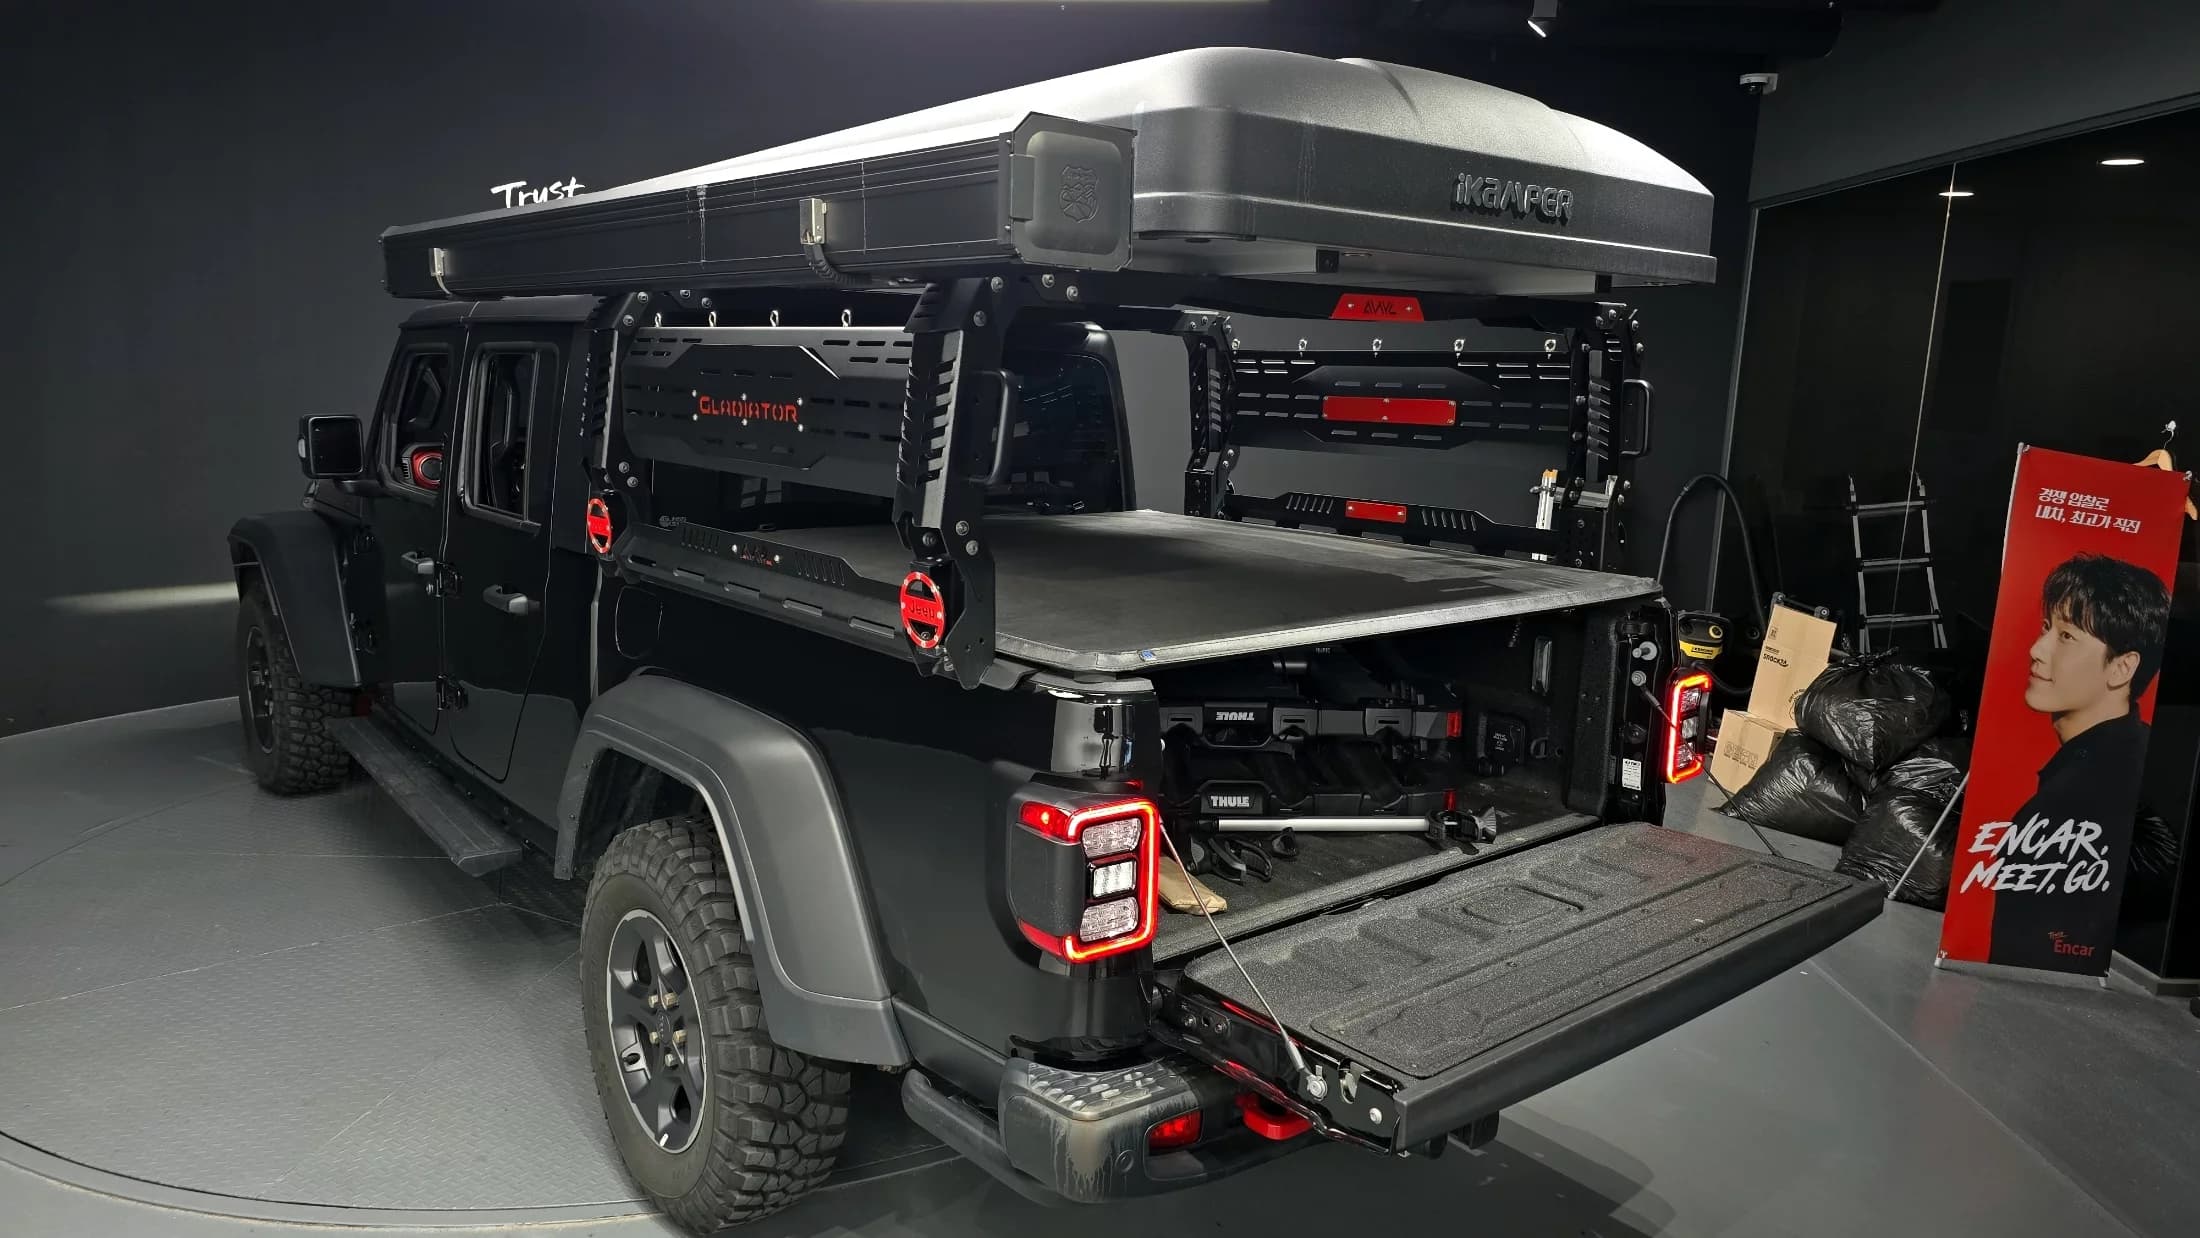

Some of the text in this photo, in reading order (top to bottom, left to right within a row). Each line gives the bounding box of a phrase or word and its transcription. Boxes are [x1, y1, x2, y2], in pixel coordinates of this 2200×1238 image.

[490, 176, 585, 208] Trust
[699, 395, 798, 422] GLADIATOR
[2038, 487, 2110, 511] 경쟁 입찰로
[2035, 504, 2141, 534] 내차, 최고가 직진
[1215, 712, 1255, 721] THULE
[1210, 795, 1250, 807] THULE
[1968, 812, 2109, 863] ENCAR.
[1960, 857, 2110, 895] MEET. GO.
[2053, 940, 2096, 957] Encar
